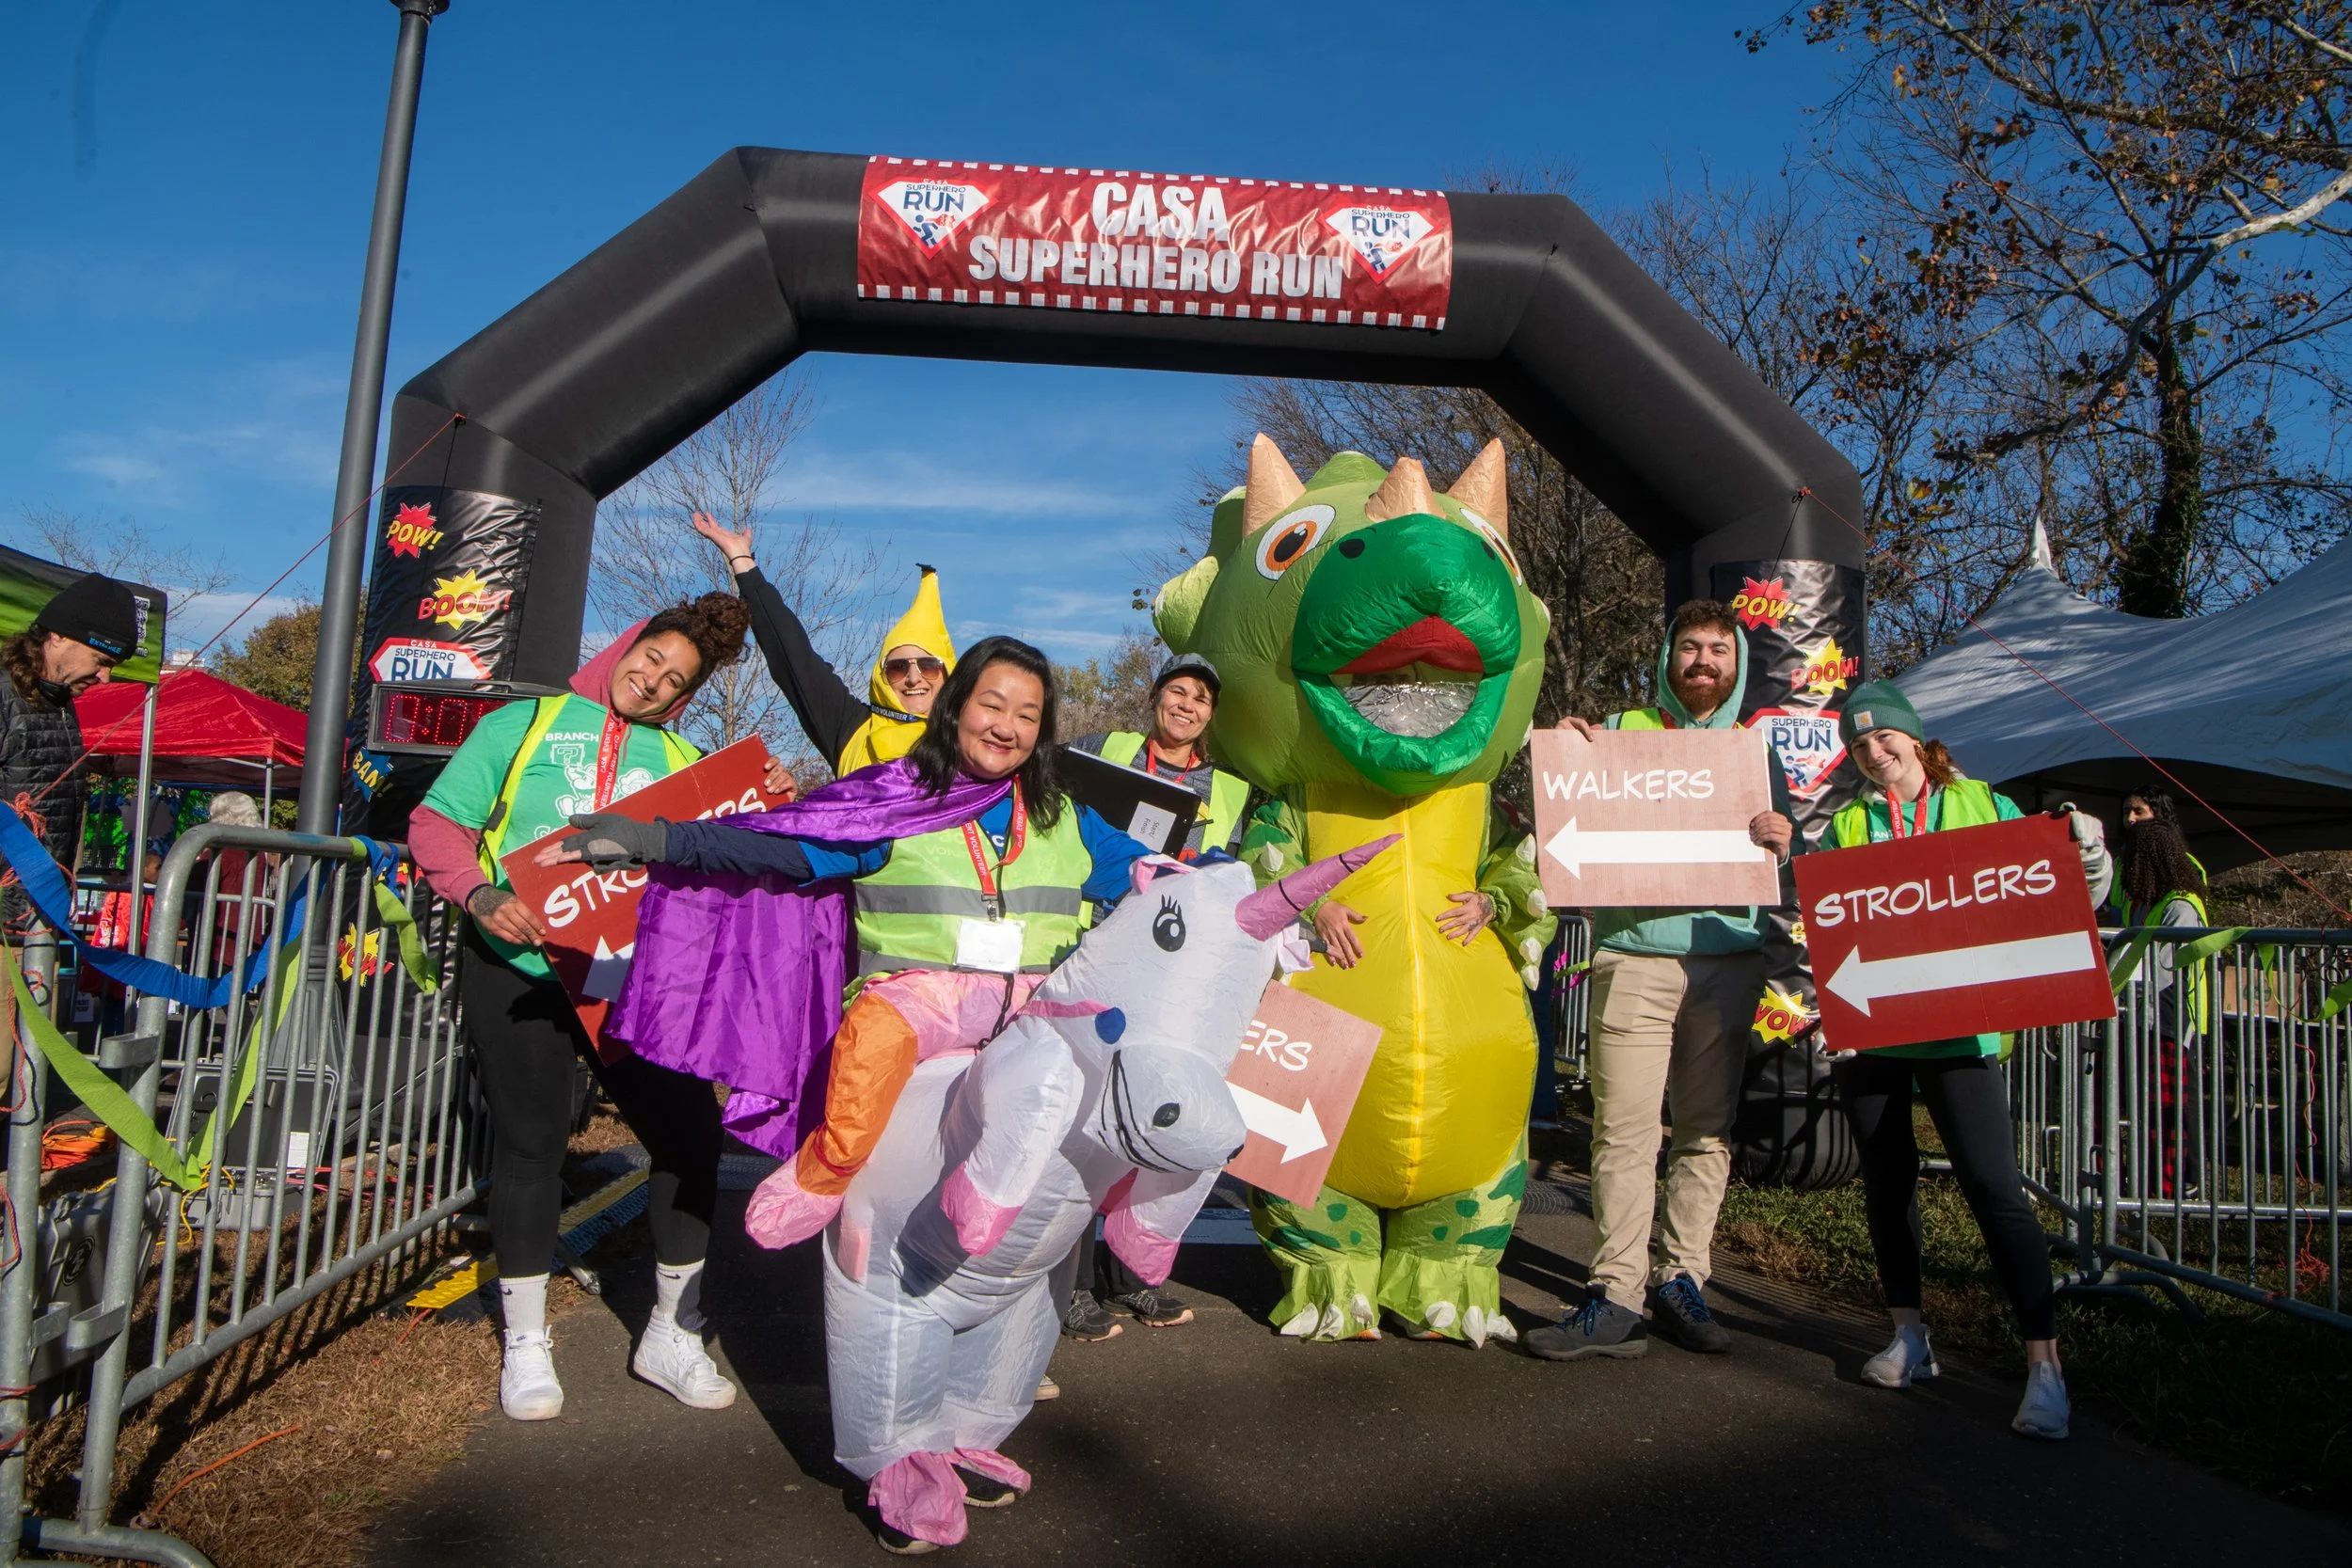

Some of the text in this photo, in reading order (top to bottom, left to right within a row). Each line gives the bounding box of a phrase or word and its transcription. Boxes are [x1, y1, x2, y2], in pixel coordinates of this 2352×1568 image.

[903, 191, 964, 212] RUN
[906, 183, 966, 193] SUPERHERO
[1091, 182, 1229, 241] CASA
[1351, 209, 1410, 218] SUPERHERO
[1352, 215, 1410, 239] RUN
[968, 235, 1343, 299] SUPERHERO RUN
[386, 519, 444, 550] POW!
[418, 590, 513, 620] BOOM!
[1731, 594, 1802, 623] POW!
[395, 648, 456, 661] SUPERHERO
[410, 640, 437, 648] CASA
[390, 657, 453, 681] RUN
[1790, 657, 1859, 689] BOOM!
[545, 732, 599, 742] BRANCH
[1772, 718, 1832, 728] SUPERHERO
[603, 732, 612, 752] EVENT
[1772, 726, 1832, 752] RUN
[352, 752, 394, 798] BAM!
[600, 771, 613, 808] VOLUNTEER
[1543, 769, 1715, 800] WALKERS
[969, 835, 987, 877] VOLUNTEER
[1815, 860, 2056, 927] STROLLERS
[1239, 1020, 1312, 1072] ERS
